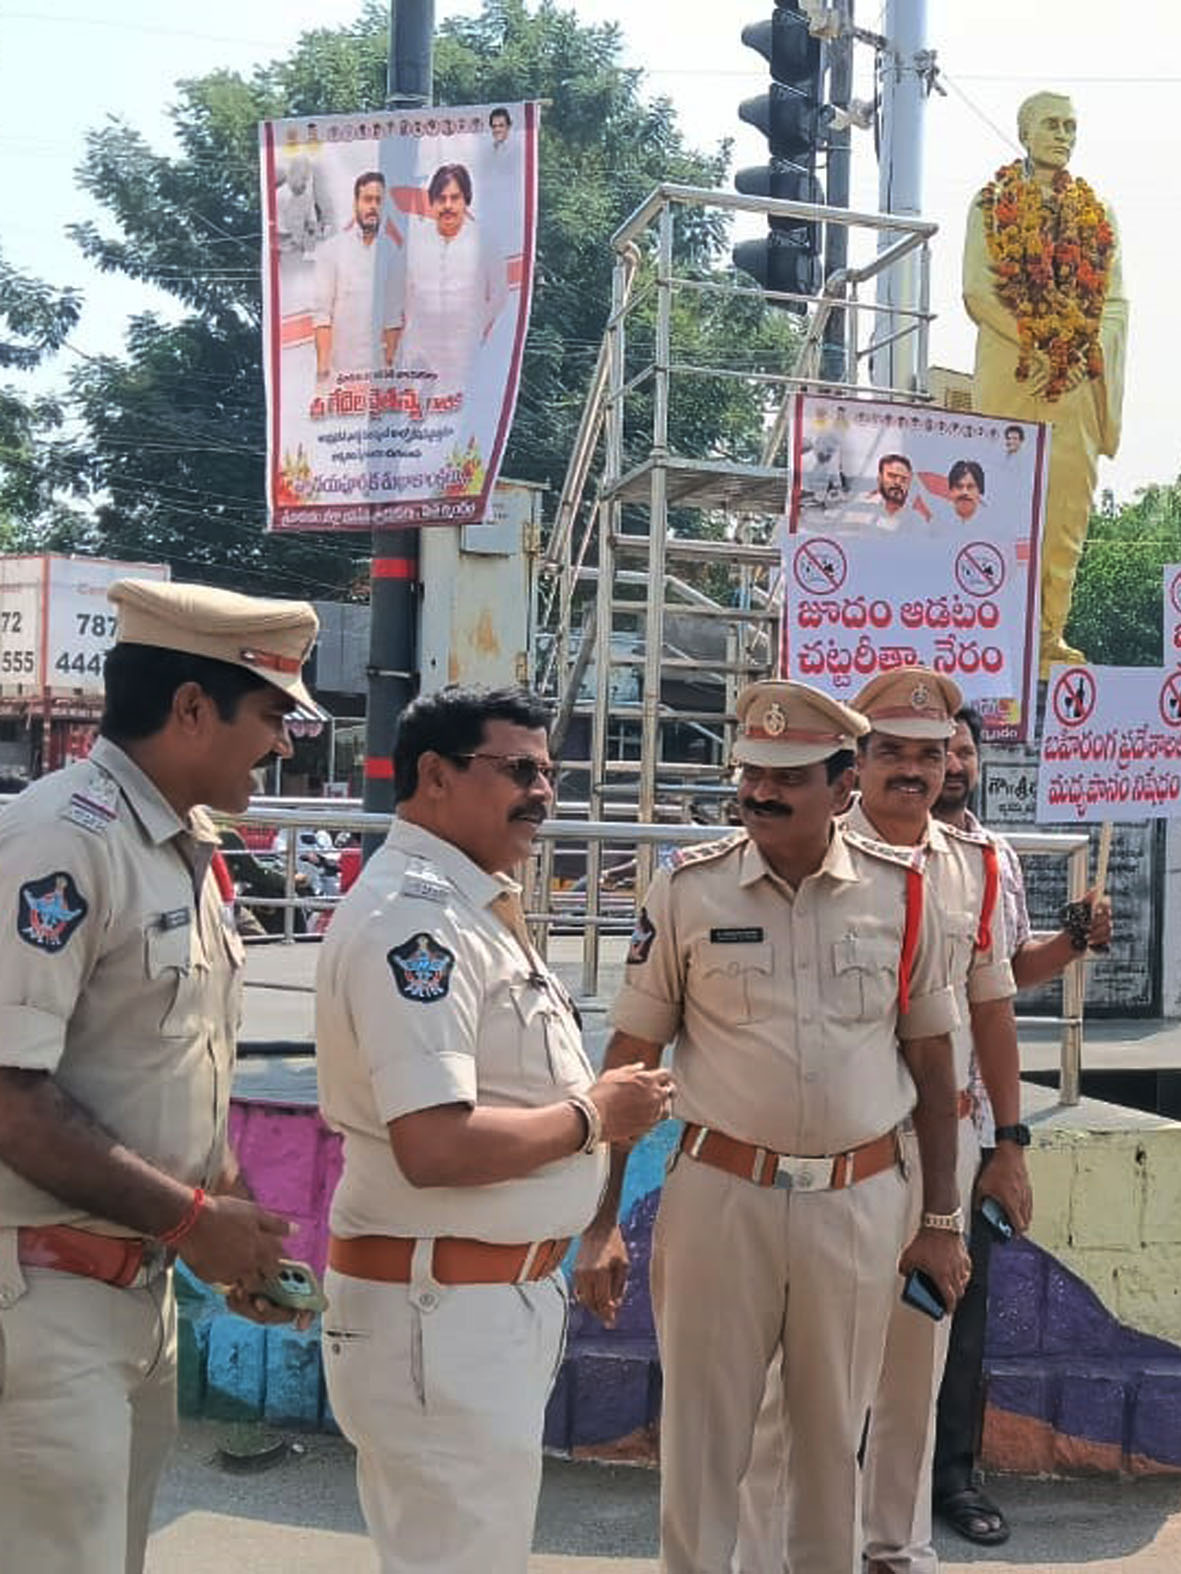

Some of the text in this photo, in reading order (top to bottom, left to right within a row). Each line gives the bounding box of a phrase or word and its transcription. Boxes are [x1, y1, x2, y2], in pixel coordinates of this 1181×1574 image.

[798, 594, 999, 628] జూదం ఆడటం
[55, 652, 105, 676] 444
[934, 633, 1003, 673] నేరం
[1044, 728, 1116, 760] బహిరంగ
[1132, 766, 1180, 805] నిషేధం
